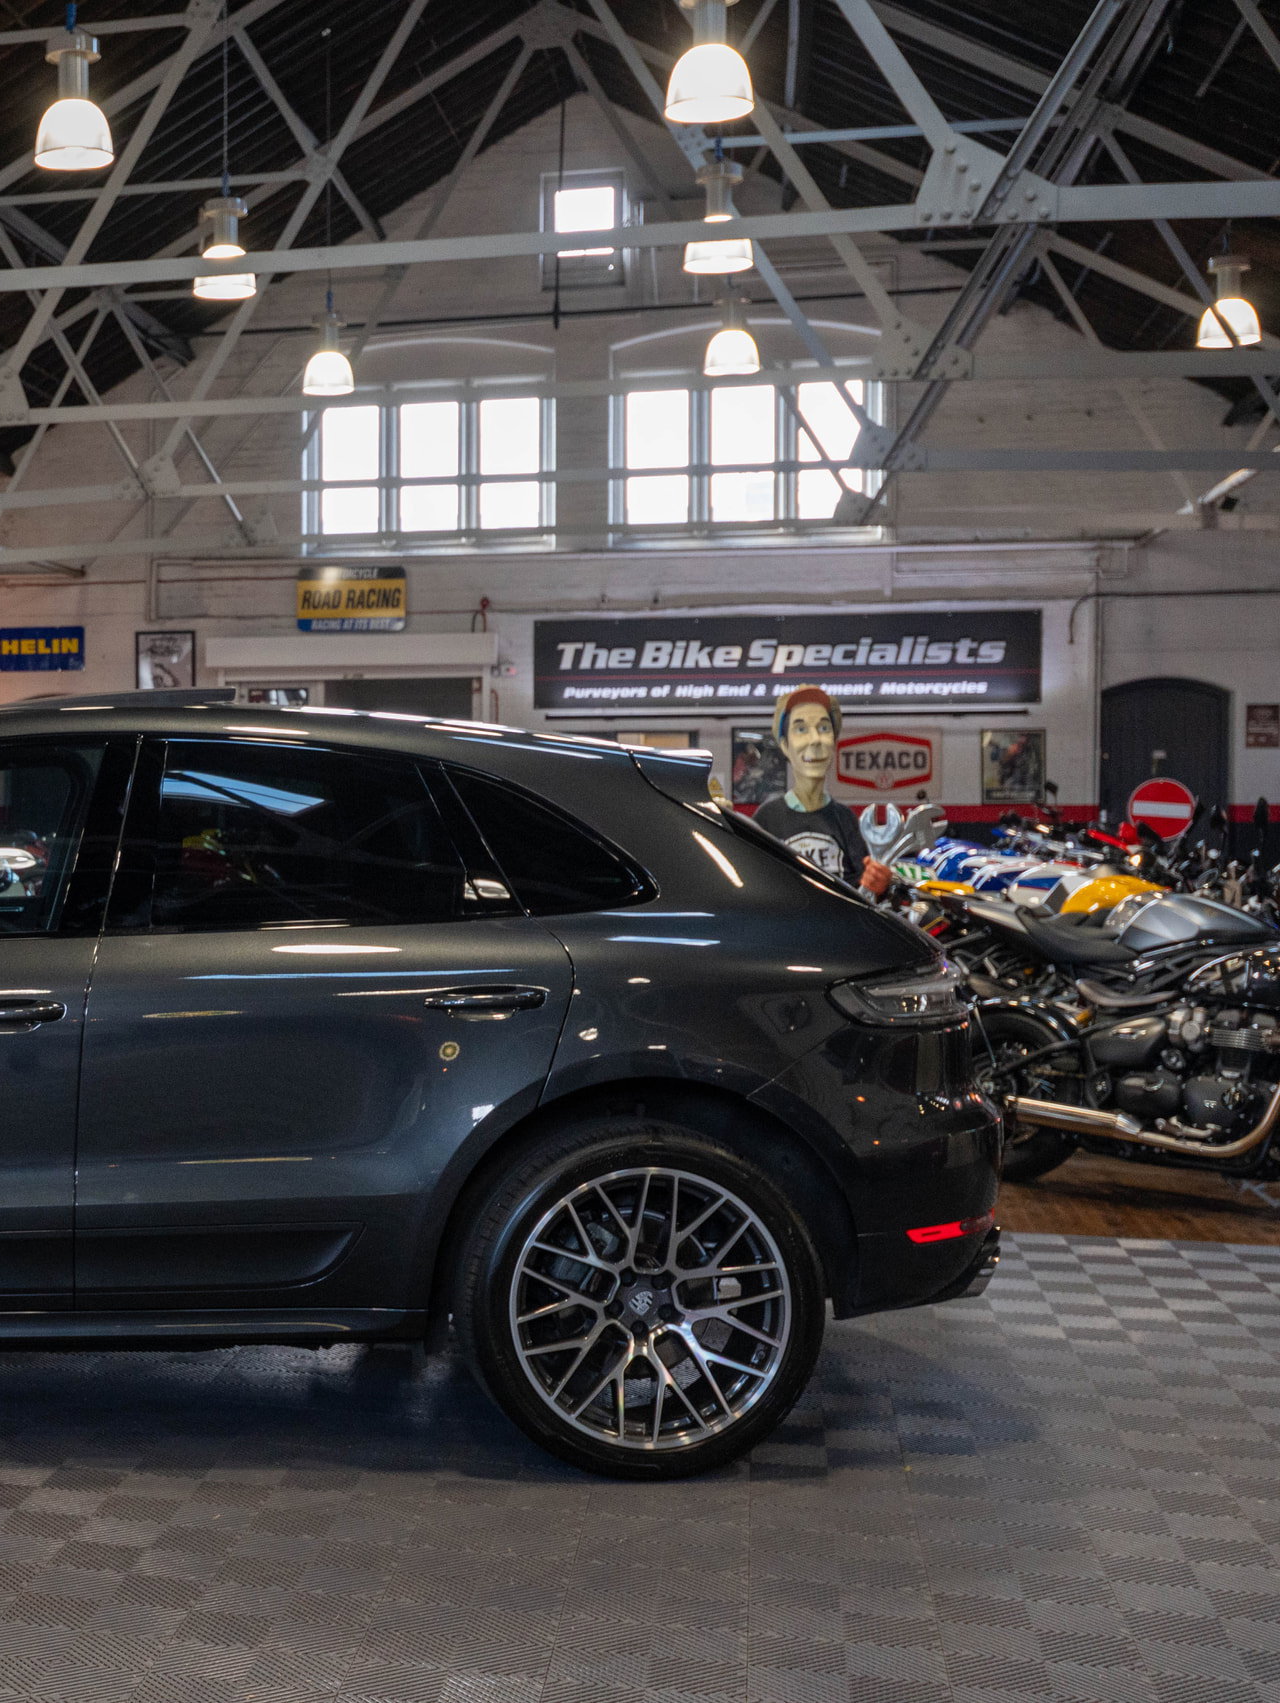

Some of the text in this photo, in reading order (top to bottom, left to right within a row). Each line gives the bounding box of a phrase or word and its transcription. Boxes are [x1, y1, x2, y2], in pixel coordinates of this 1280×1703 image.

[301, 587, 401, 610] ROAD RACING
[557, 636, 1006, 674] The Bike Specialists
[563, 686, 648, 699] Purveyors
[650, 685, 670, 698] of
[675, 683, 714, 699] High
[717, 683, 750, 697] End
[753, 684, 766, 697] &
[879, 681, 987, 696] Motorcycles
[842, 751, 927, 770] TEXACO
